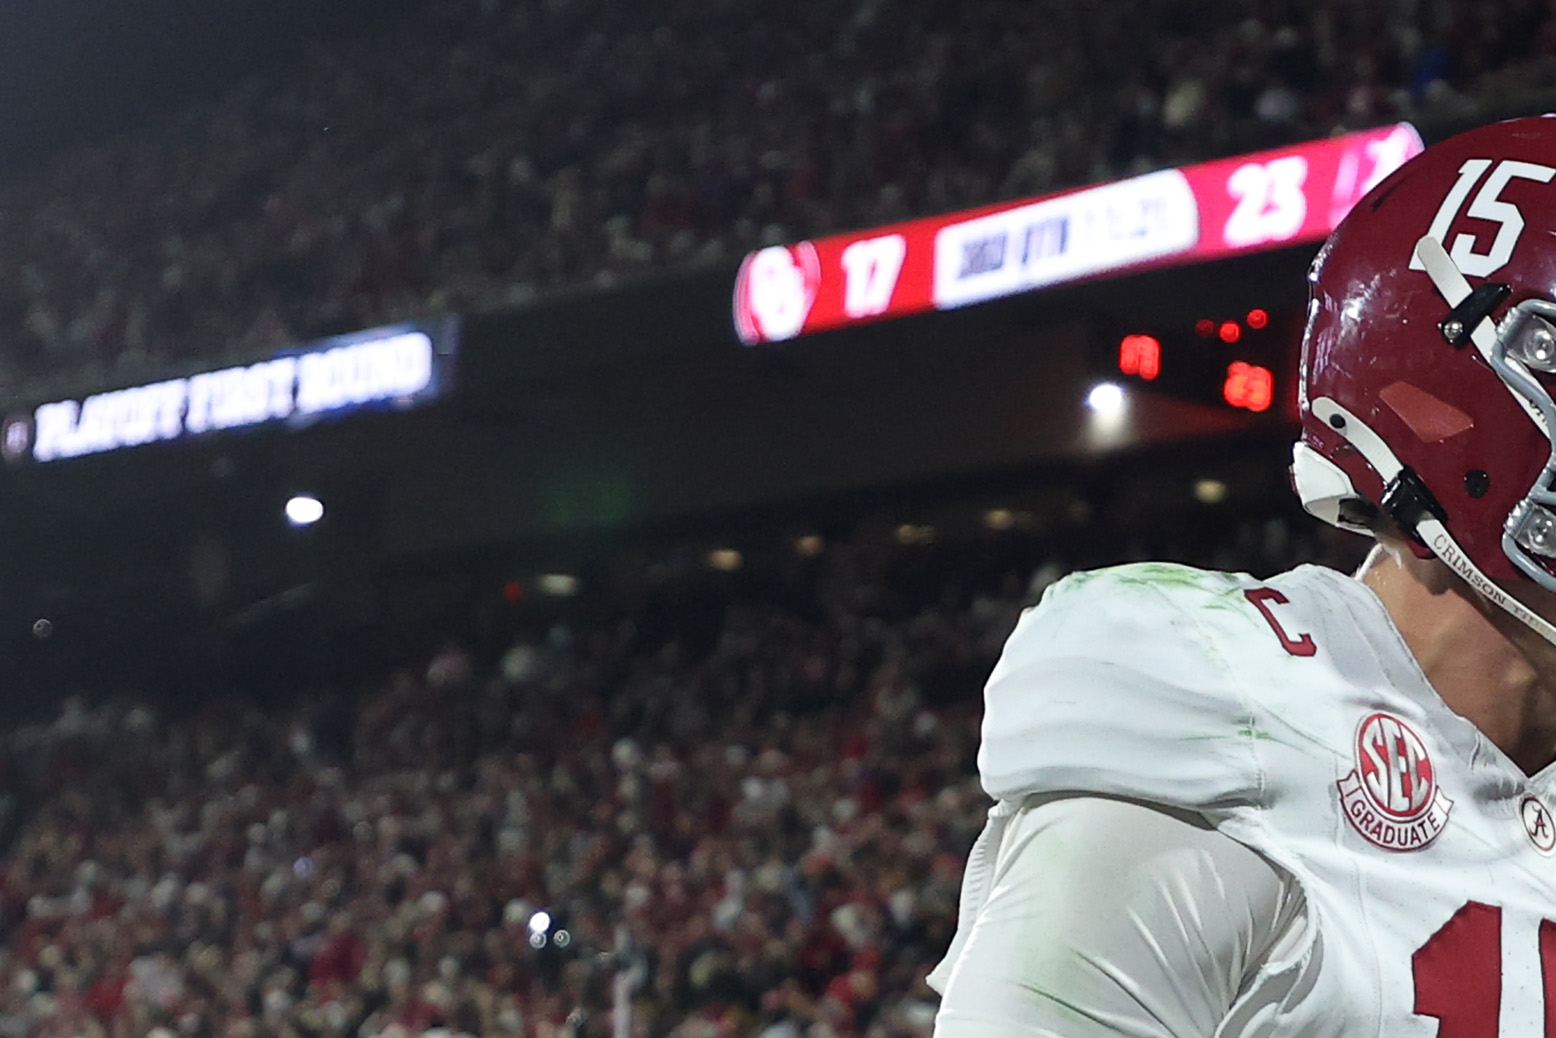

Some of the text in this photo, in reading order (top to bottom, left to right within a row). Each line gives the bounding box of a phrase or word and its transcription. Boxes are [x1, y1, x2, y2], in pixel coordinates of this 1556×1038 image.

[1223, 155, 1308, 248] 23
[1409, 158, 1556, 278] 15
[841, 234, 907, 319] 17
[1433, 533, 1507, 606] CRIMSON
[1244, 587, 1317, 658] C
[1361, 716, 1430, 812] SEC
[1350, 798, 1440, 847] GRADUATE
[1528, 804, 1549, 839] A
